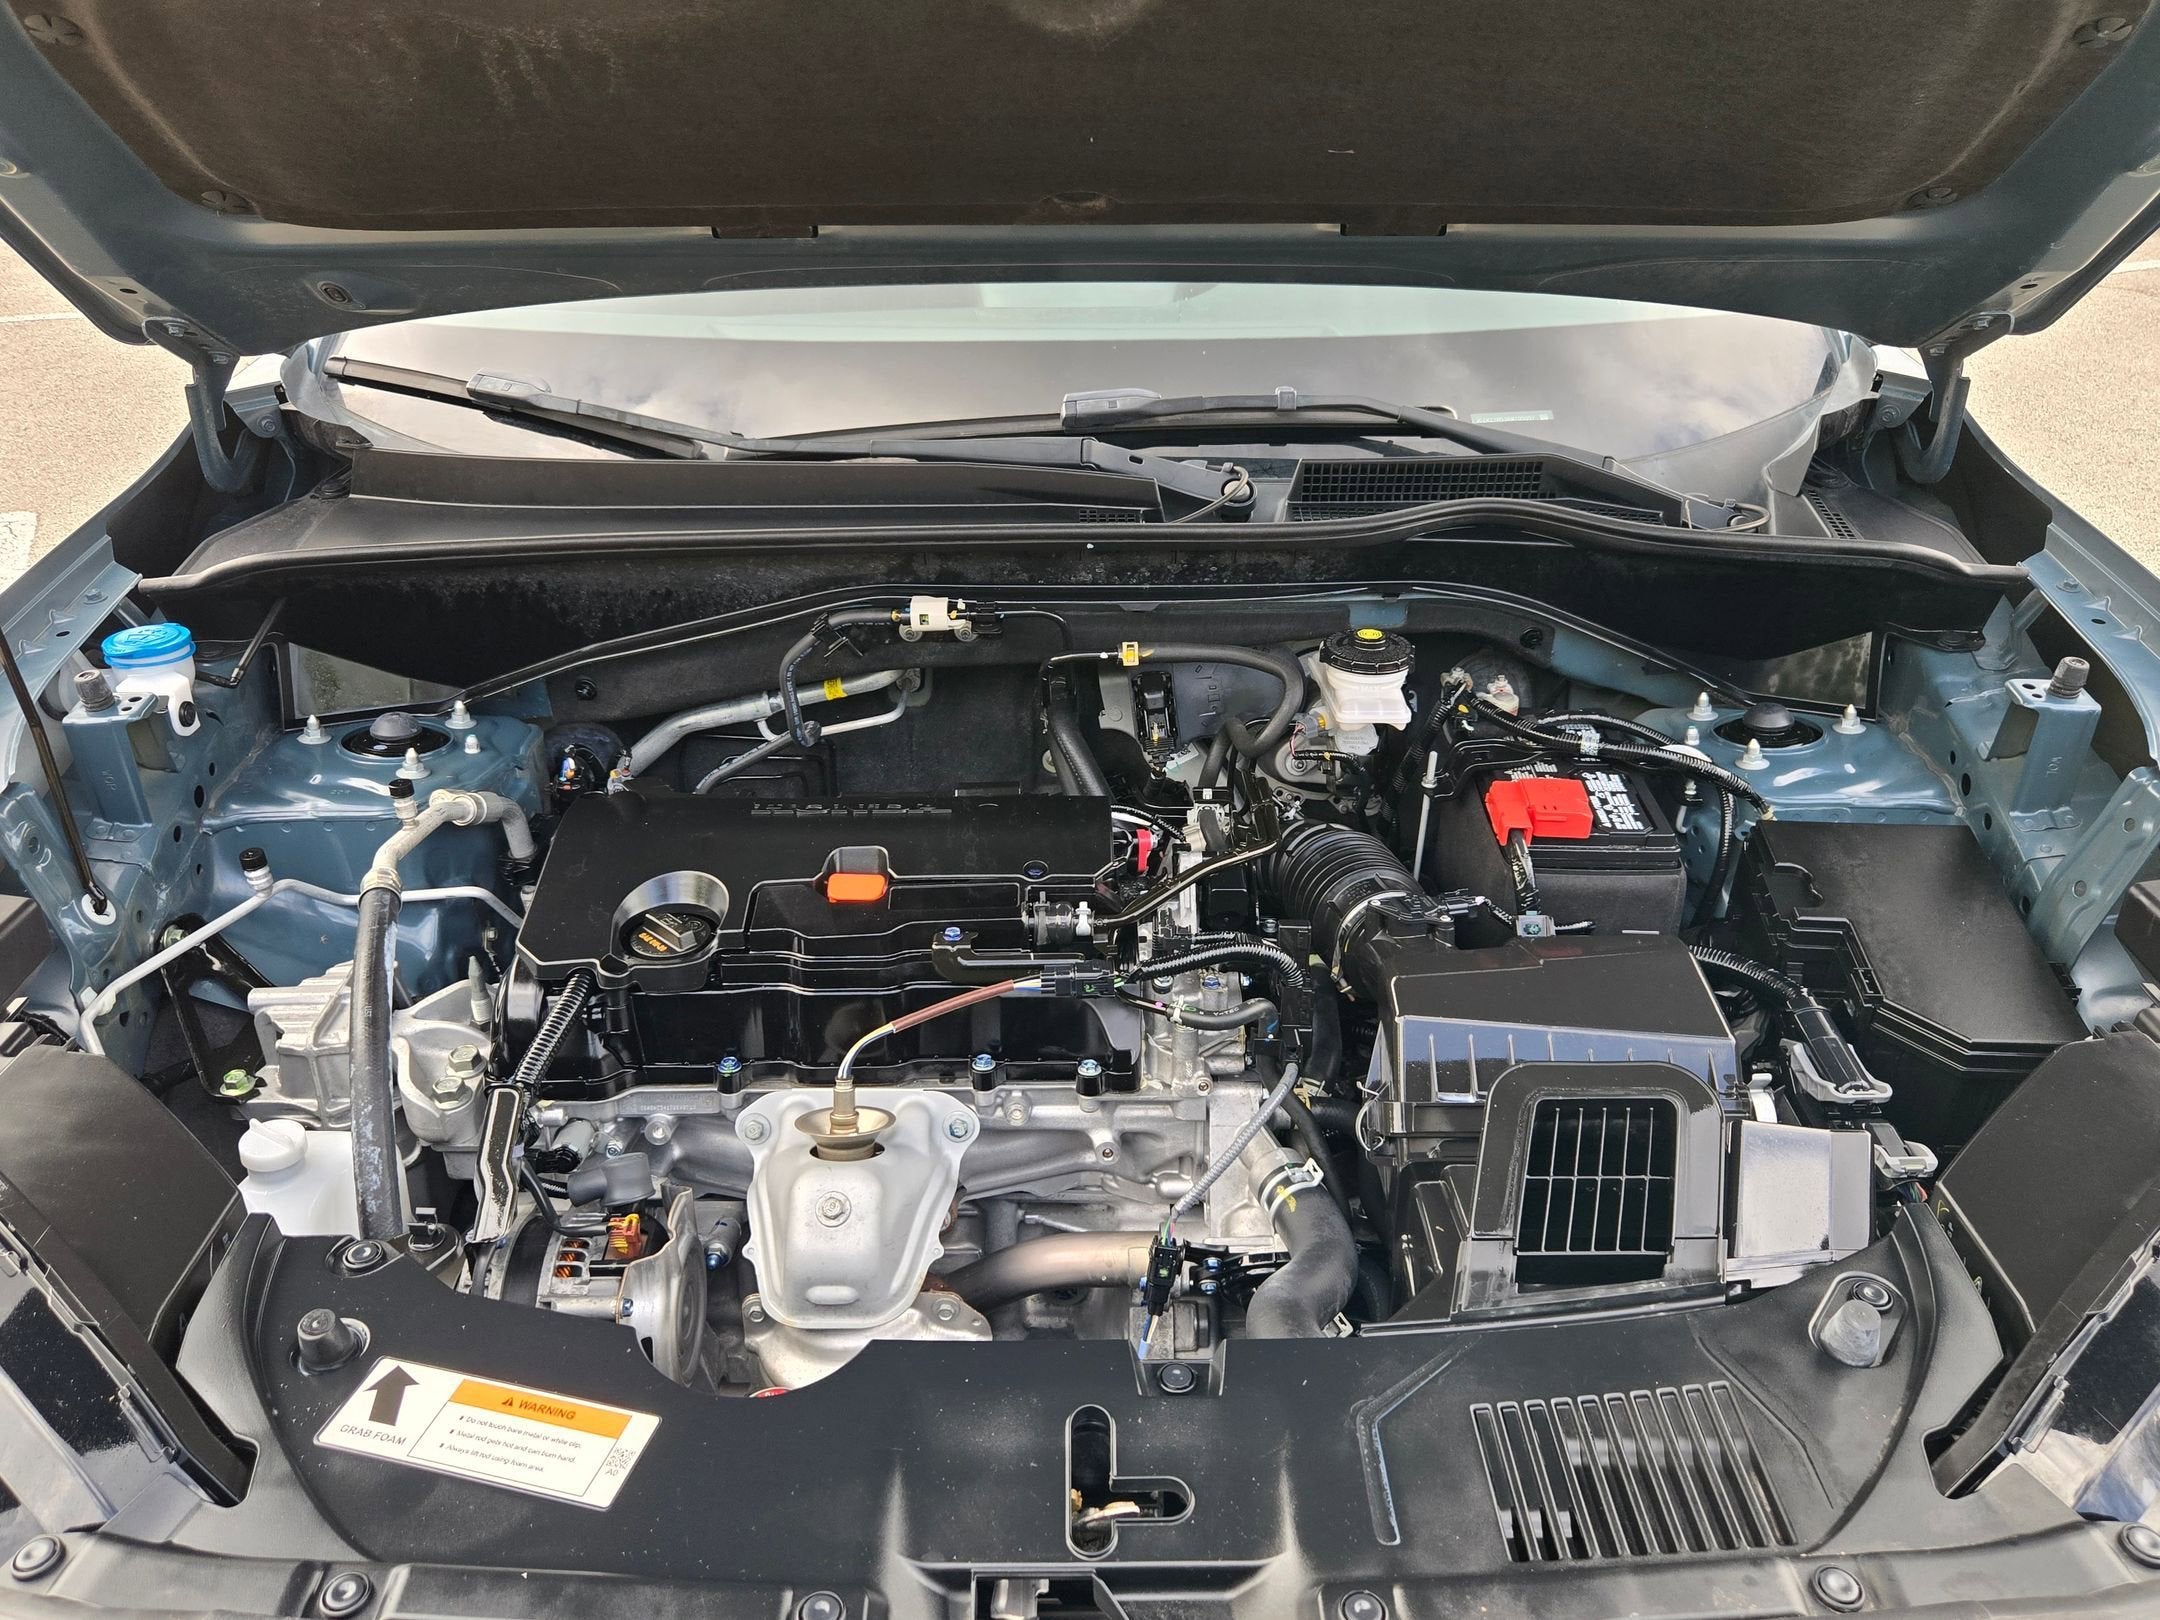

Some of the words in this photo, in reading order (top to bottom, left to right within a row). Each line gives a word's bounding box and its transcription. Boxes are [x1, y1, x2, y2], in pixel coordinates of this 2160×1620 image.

[518, 1399, 577, 1420] WARNING
[340, 1424, 373, 1438] GRAB
[372, 1431, 407, 1446] FOAM
[465, 1415, 477, 1424] Do
[476, 1419, 489, 1427] not
[488, 1421, 507, 1431] touch
[506, 1426, 523, 1435] bare
[522, 1430, 543, 1439] metal
[550, 1436, 569, 1445] white
[444, 1443, 470, 1455] Always
[479, 1451, 492, 1459] rod
[490, 1455, 510, 1465] using
[510, 1458, 528, 1468] foam
[456, 1429, 476, 1439] Metal
[475, 1434, 488, 1442] rod
[486, 1438, 502, 1446] gets
[502, 1440, 515, 1449] hot
[514, 1444, 528, 1452] and
[527, 1447, 541, 1455] can
[540, 1449, 557, 1459] burn
